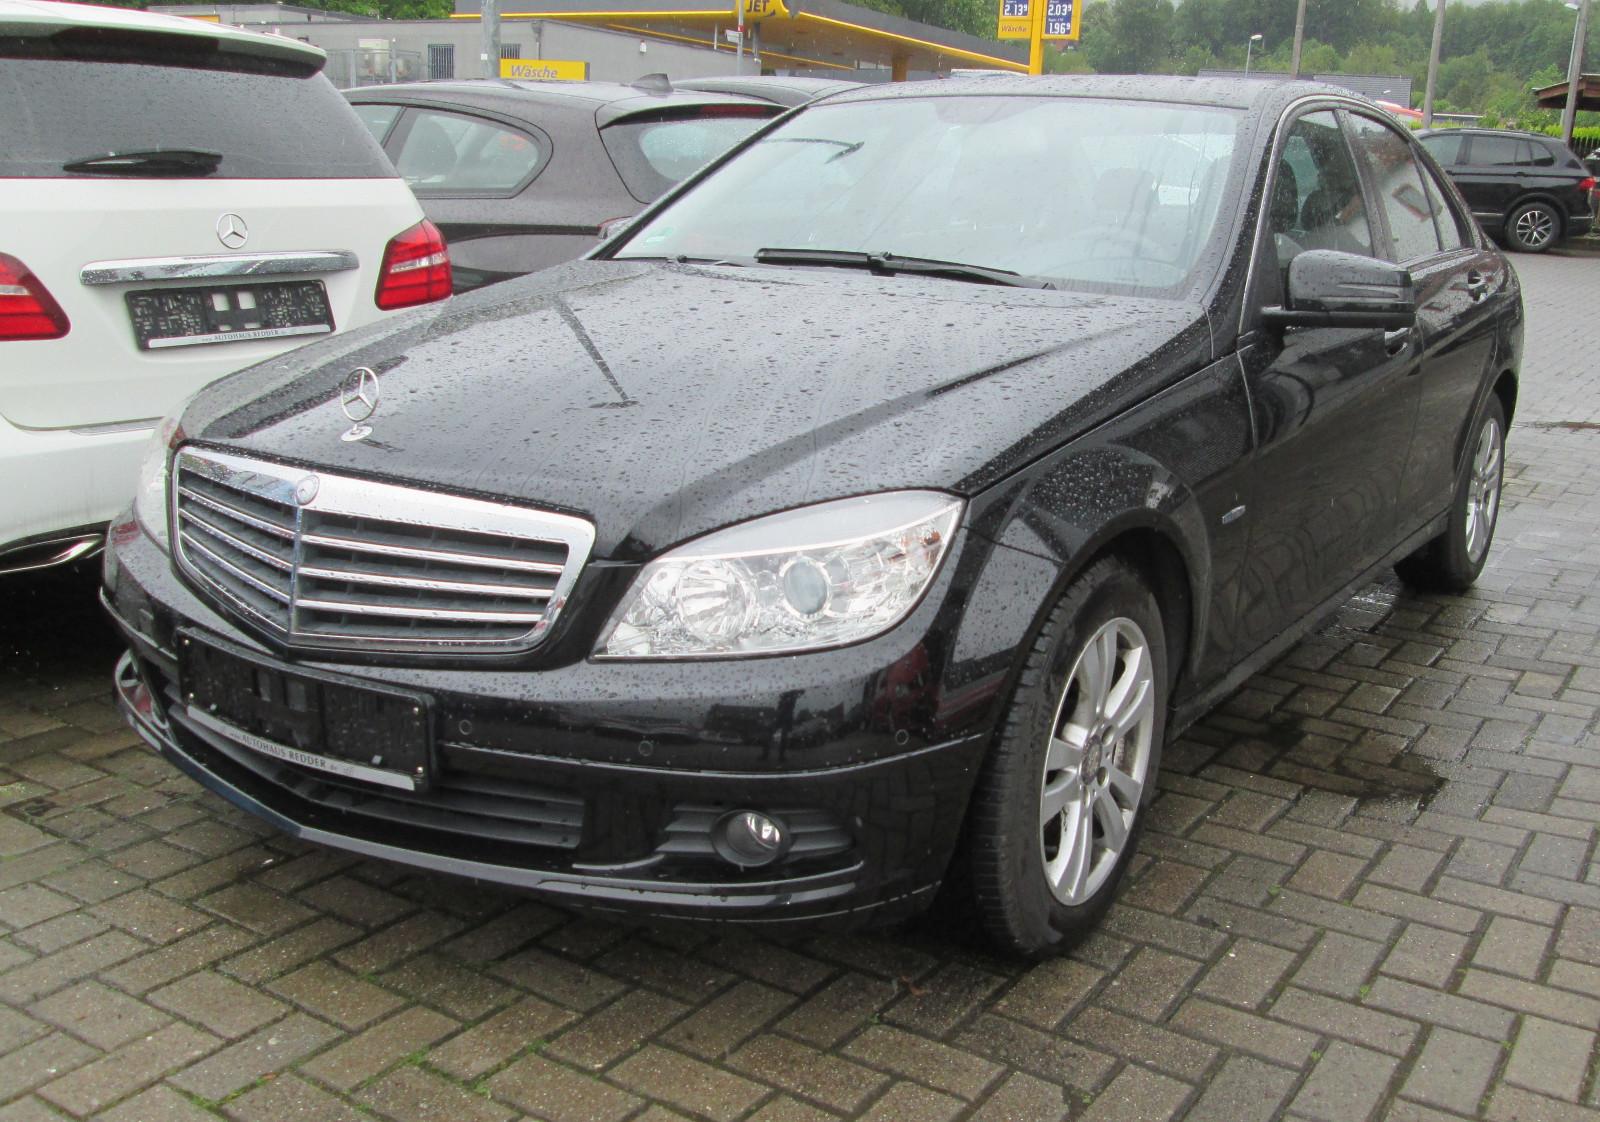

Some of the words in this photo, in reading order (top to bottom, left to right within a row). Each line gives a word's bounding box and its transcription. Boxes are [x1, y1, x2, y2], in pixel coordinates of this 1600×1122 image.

[746, 0, 770, 12] JET
[511, 63, 557, 78] Wäsche
[241, 734, 287, 758] AUTOHAUS
[288, 751, 327, 769] REDDER
